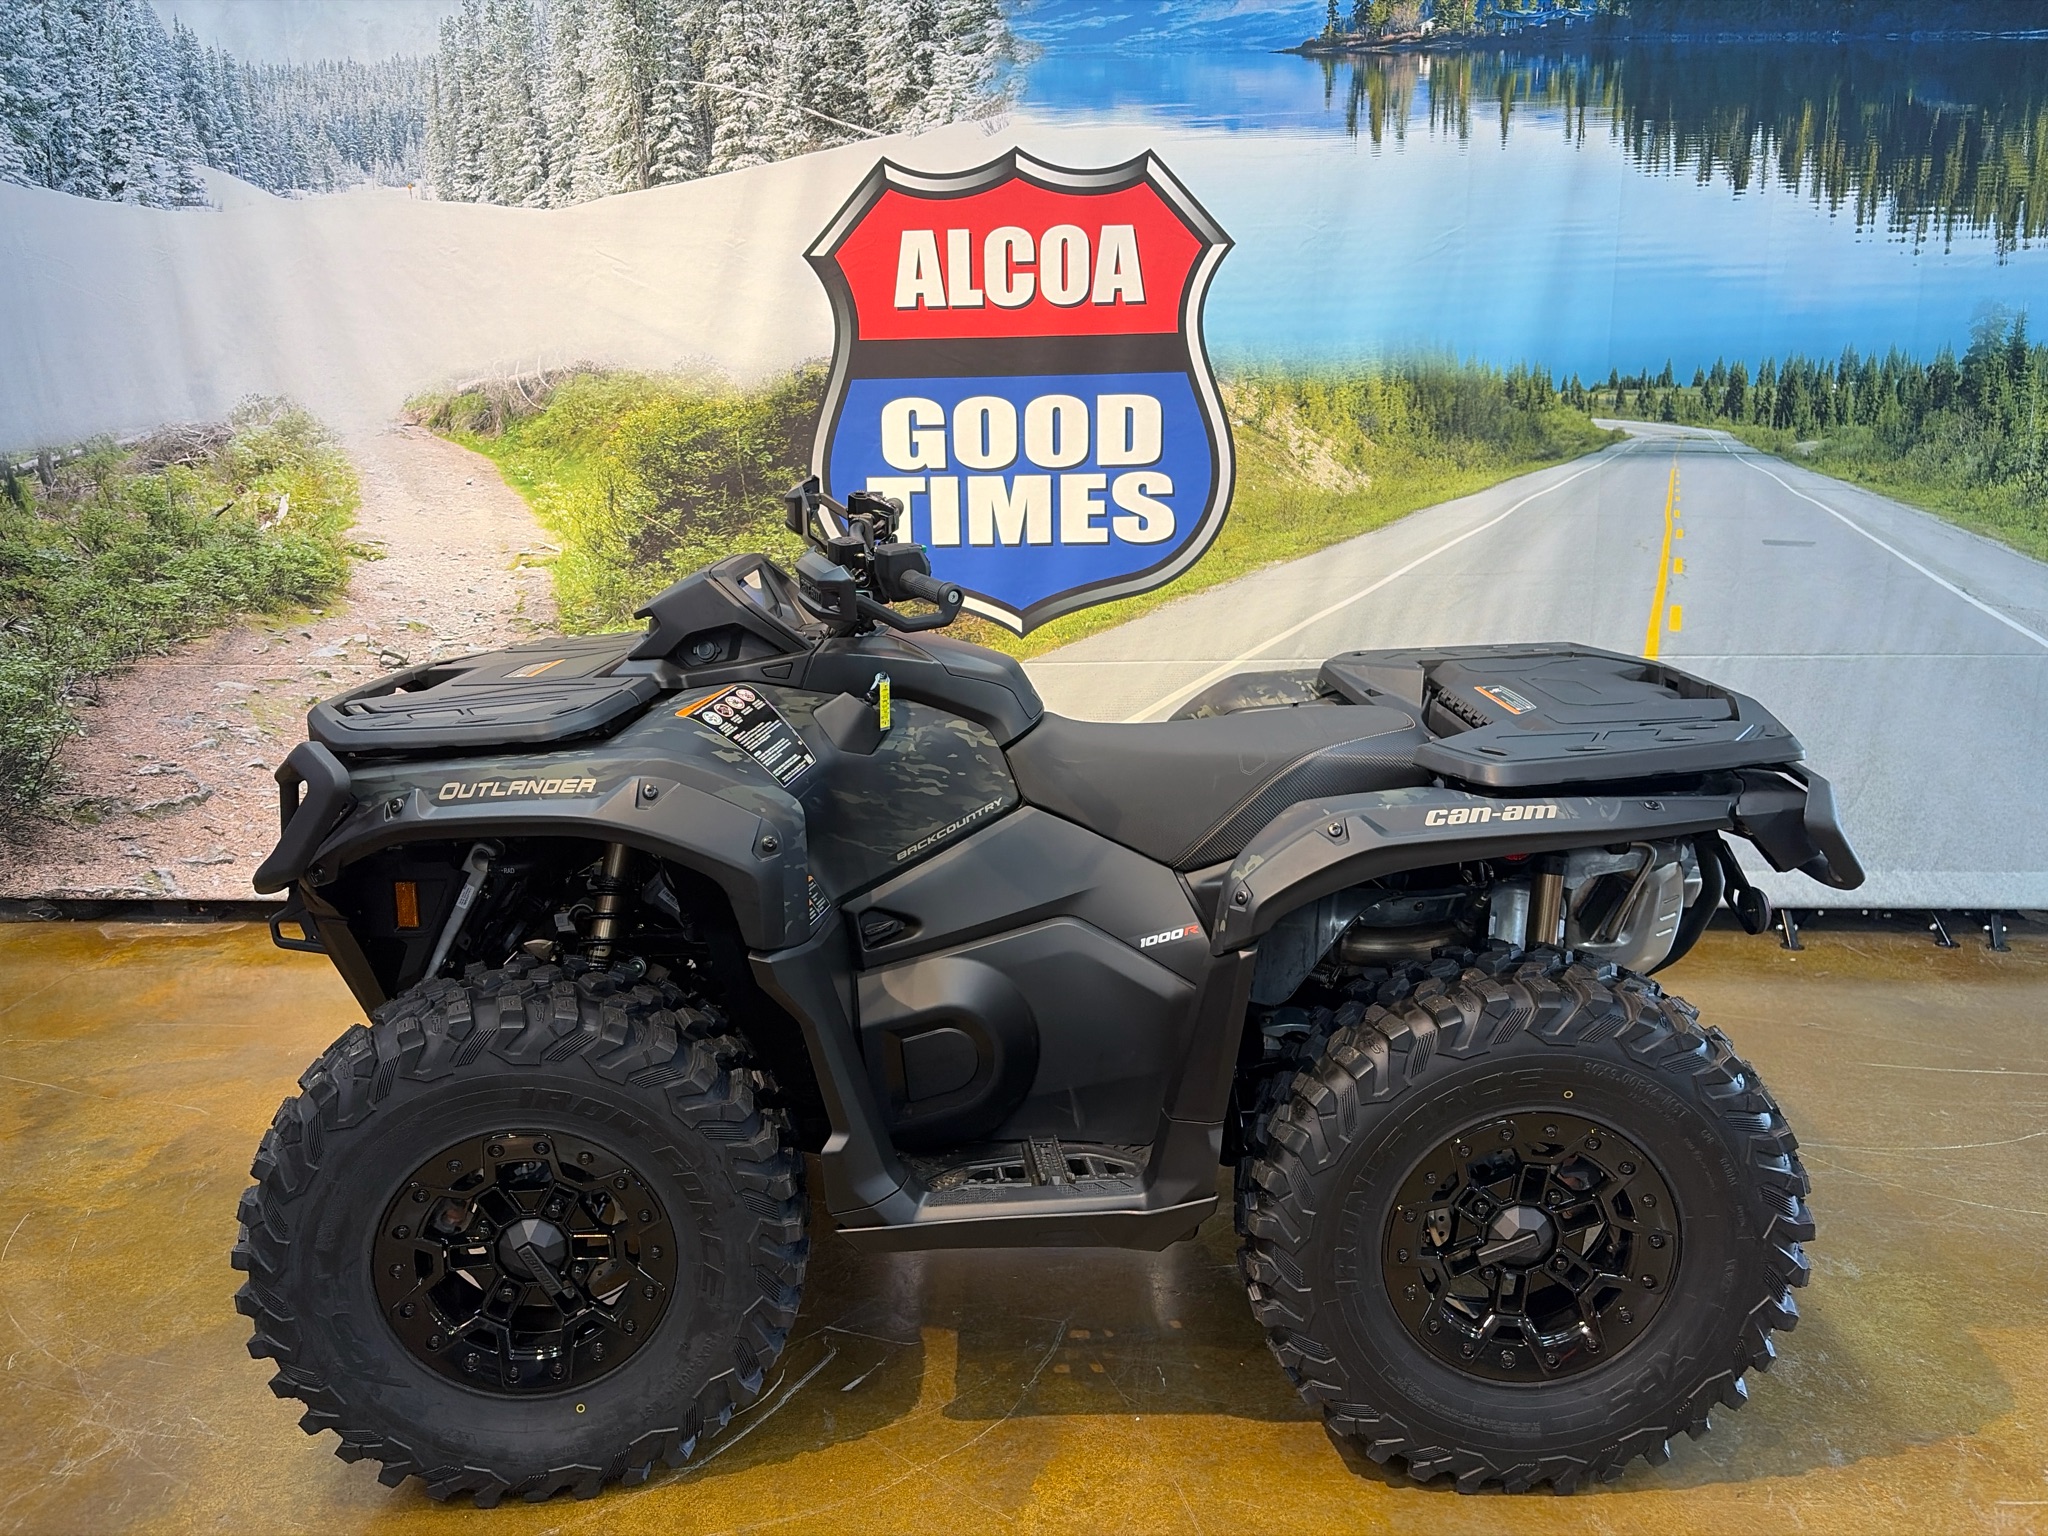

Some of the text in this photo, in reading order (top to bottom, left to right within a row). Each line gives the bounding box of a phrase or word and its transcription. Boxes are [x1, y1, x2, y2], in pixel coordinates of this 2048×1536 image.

[893, 224, 1147, 309] ALCOA
[880, 394, 1163, 471] GOOD
[866, 471, 1177, 547] TIMES
[438, 778, 597, 801] OUTLANDER
[1424, 804, 1558, 827] can-am
[896, 797, 1003, 861] BACKCOUNTRY
[1140, 924, 1199, 949] 1000R
